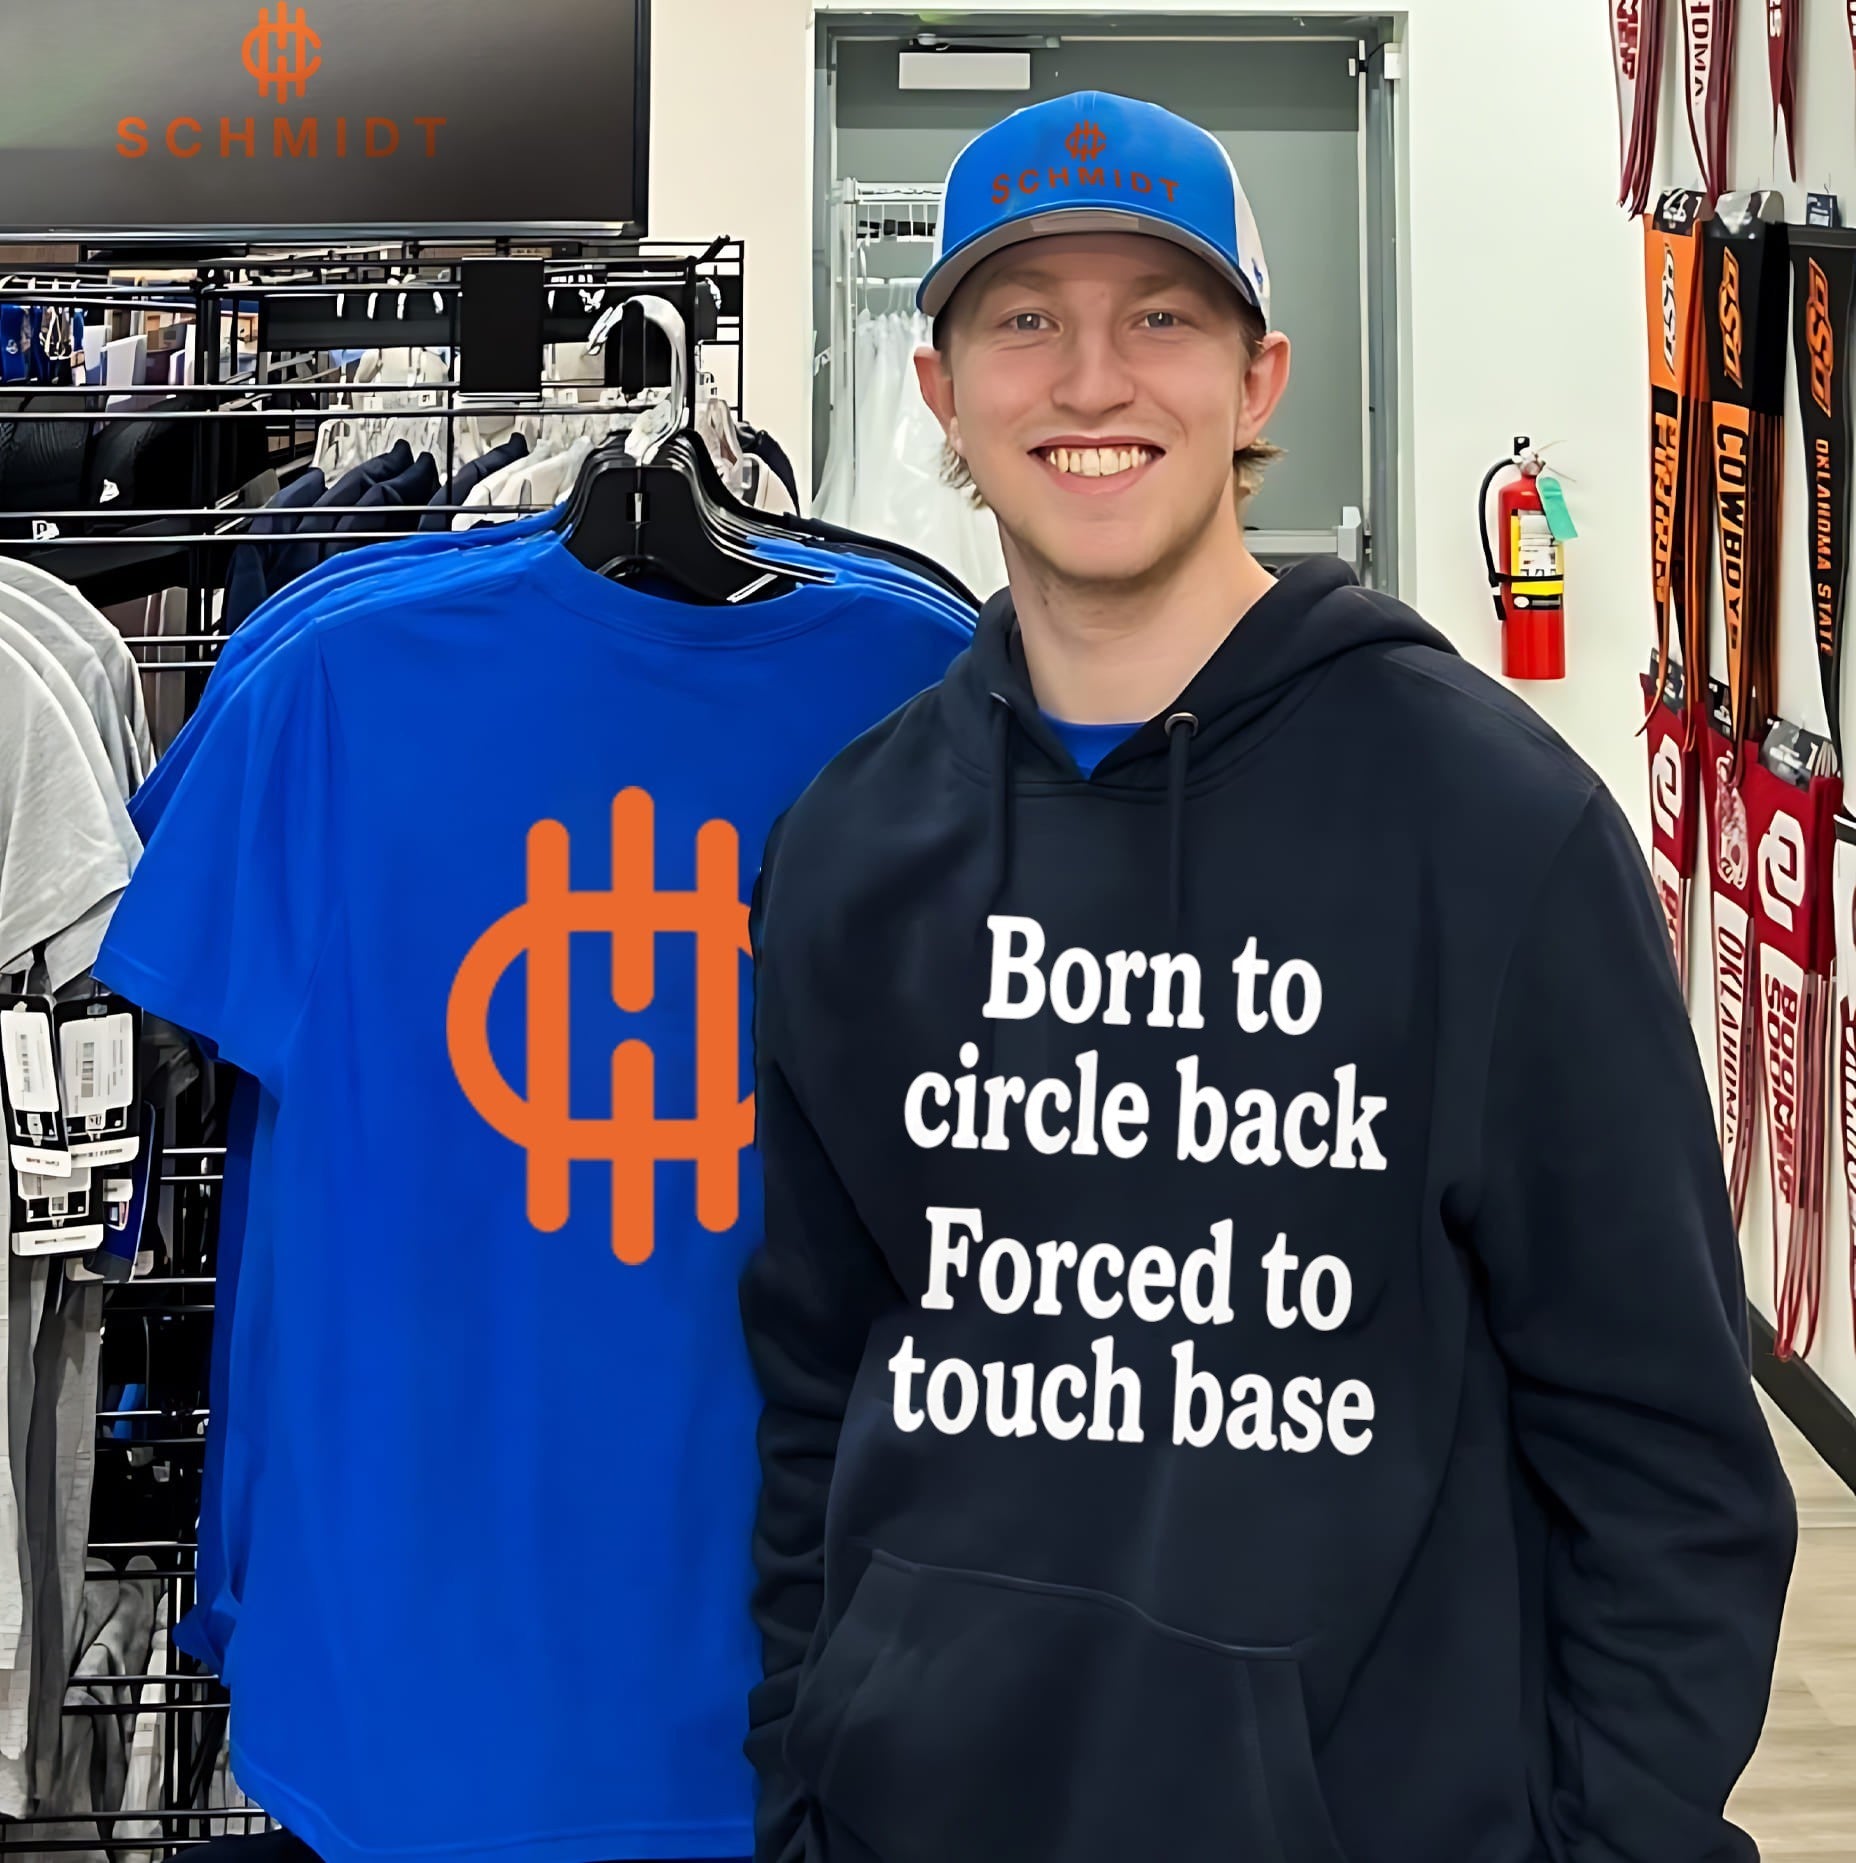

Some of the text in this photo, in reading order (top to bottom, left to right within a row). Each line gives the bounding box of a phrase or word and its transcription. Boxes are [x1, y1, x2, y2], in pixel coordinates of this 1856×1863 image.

[116, 116, 446, 159] SCHMIDT
[991, 167, 1179, 205] SCHMIDT
[1815, 438, 1832, 571] OKLAHOMA
[982, 914, 1323, 1035] Born to
[1718, 925, 1746, 1143] OKLAHOMA
[904, 1041, 1388, 1171] circle back
[921, 1206, 1353, 1332] Forced to
[888, 1334, 1376, 1456] touch base
